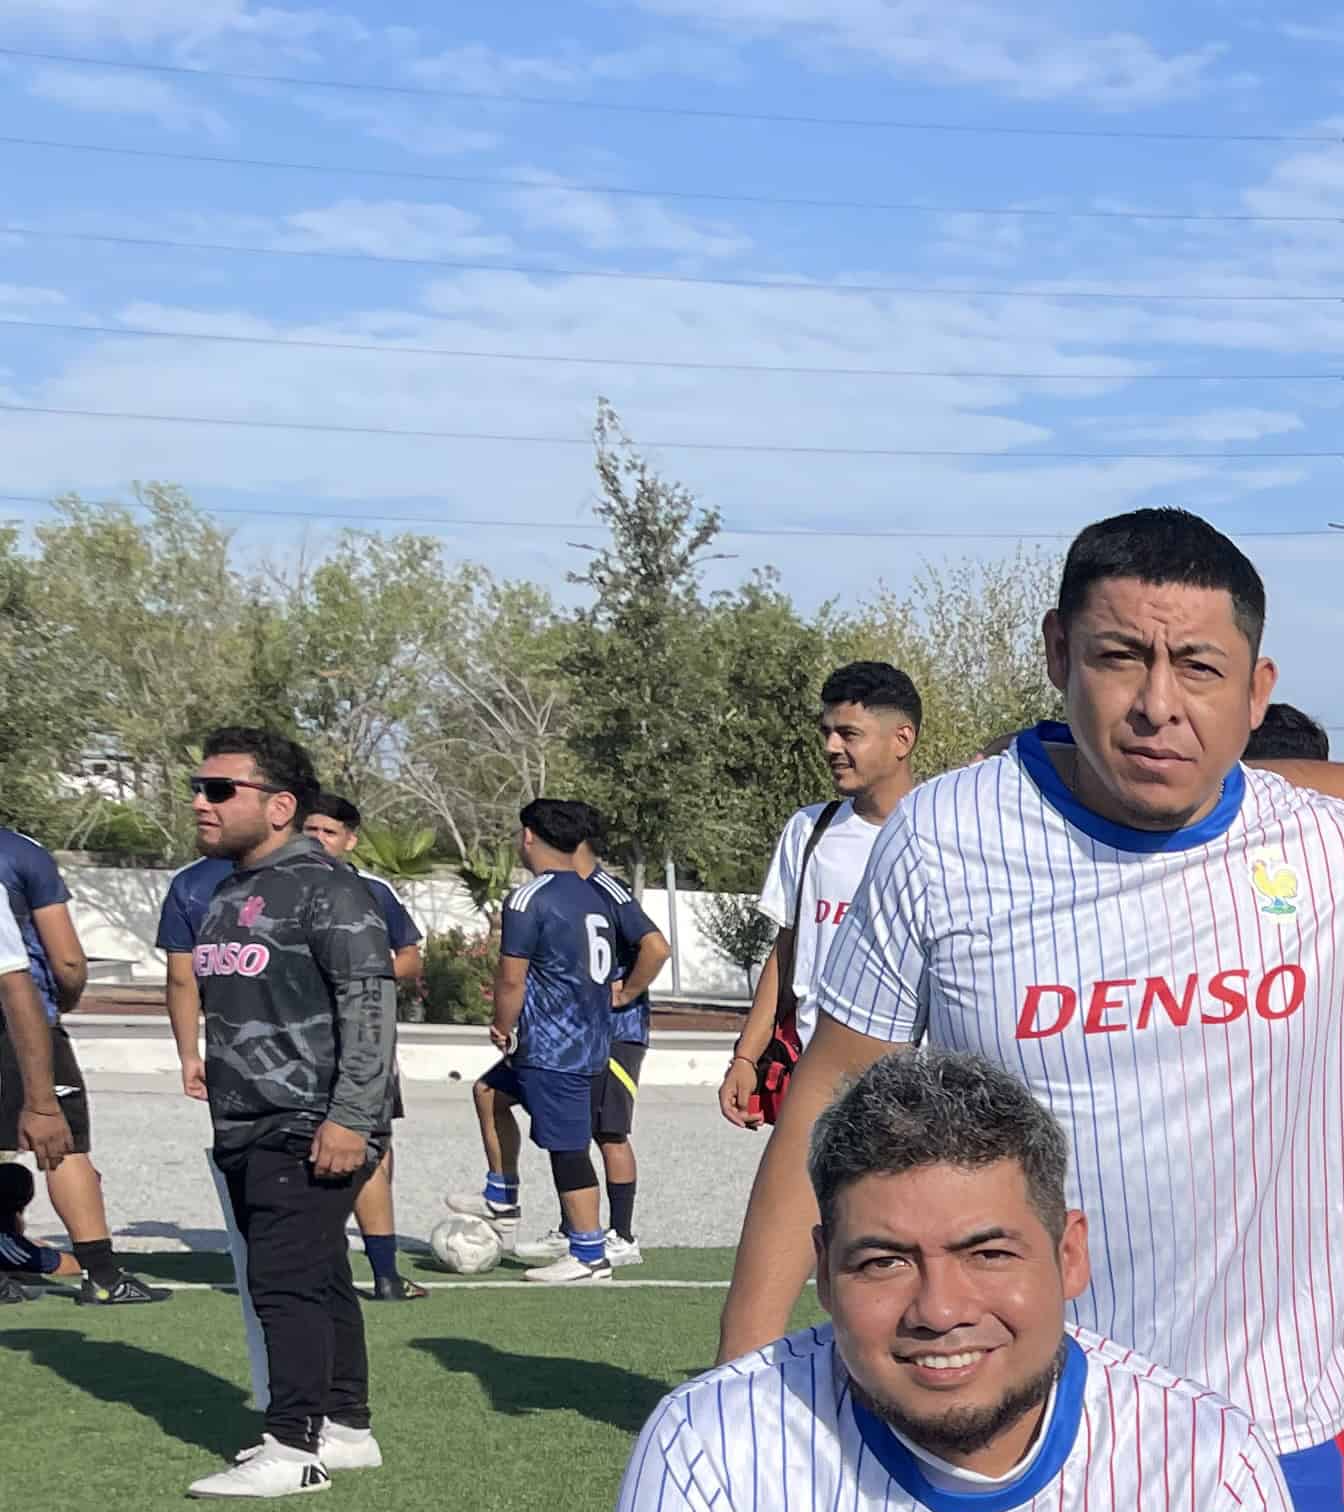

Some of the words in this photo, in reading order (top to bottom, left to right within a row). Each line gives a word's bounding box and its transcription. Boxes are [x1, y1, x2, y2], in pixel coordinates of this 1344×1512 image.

[192, 942, 269, 977] ENSO
[585, 913, 611, 984] 6
[1015, 964, 1307, 1040] DENSO
